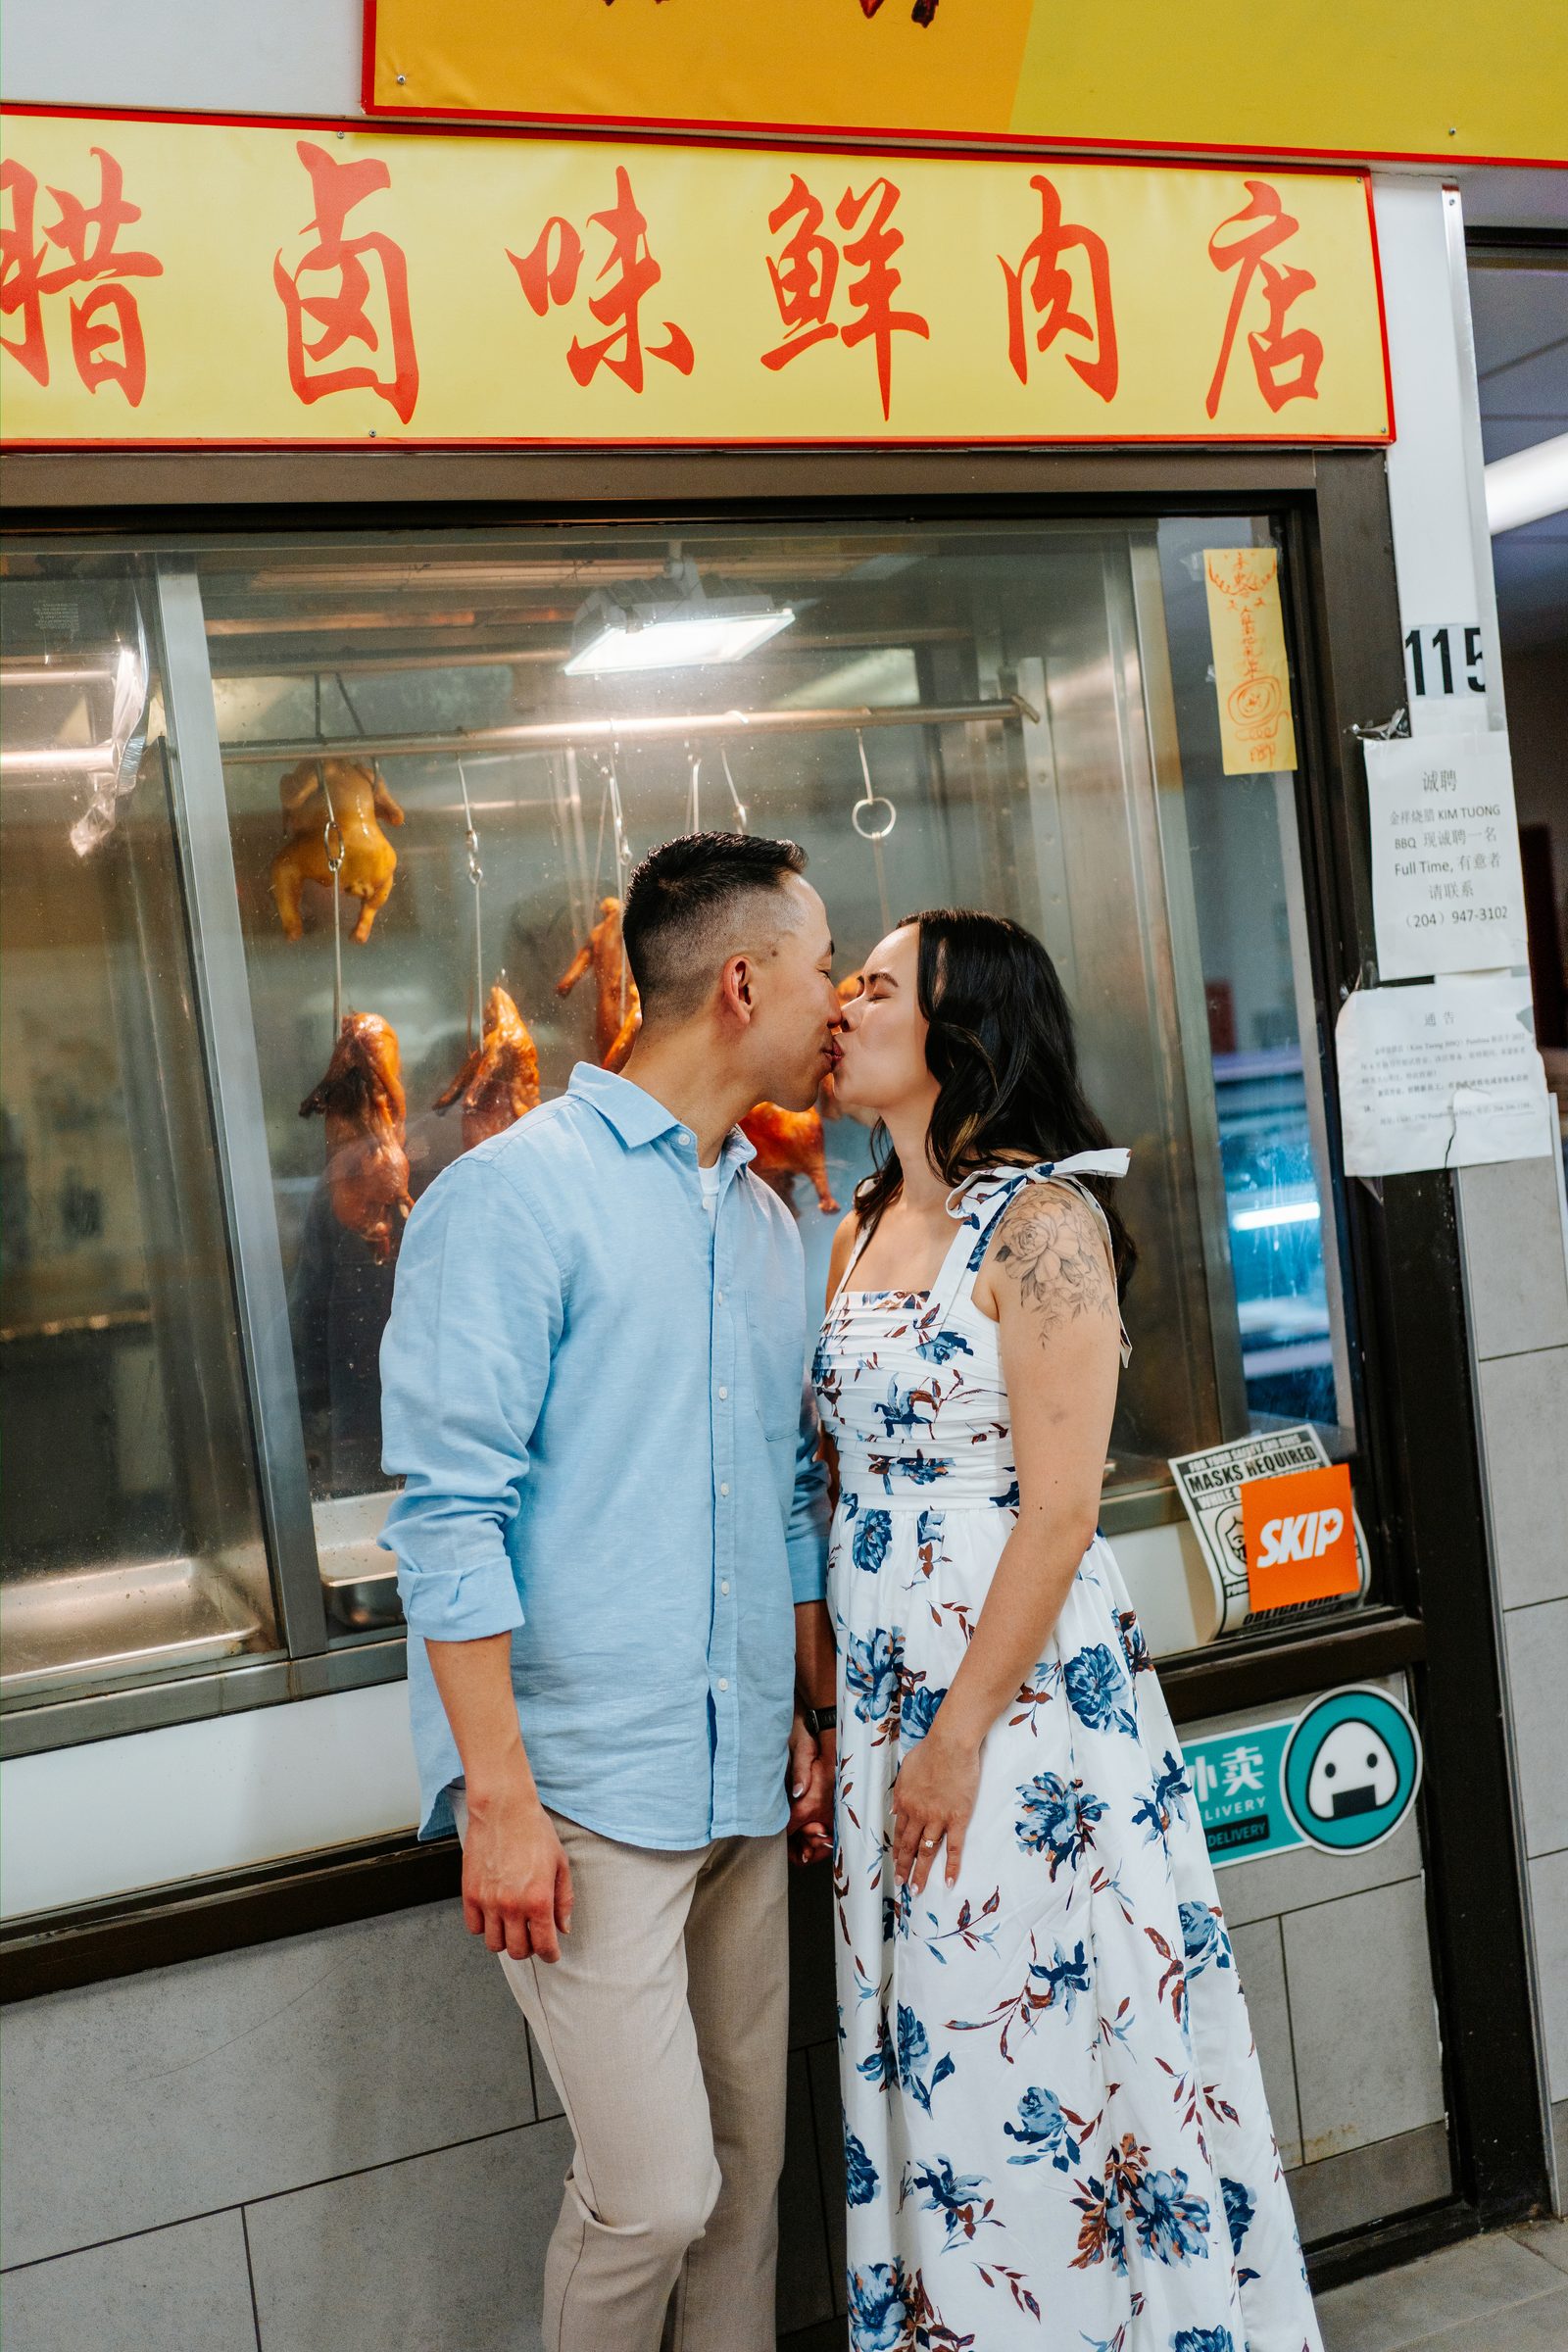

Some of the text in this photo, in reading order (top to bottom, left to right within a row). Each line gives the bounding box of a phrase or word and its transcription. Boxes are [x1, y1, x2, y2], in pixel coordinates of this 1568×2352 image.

[1404, 627, 1486, 696] 115
[1422, 769, 1457, 792] 诚聘
[1438, 808, 1458, 821] KIM
[1460, 805, 1500, 819] TUONG
[1395, 837, 1416, 850] BBQ
[1395, 861, 1416, 876] Full
[1419, 860, 1453, 874] Time,
[1430, 880, 1474, 901] 请联系
[1451, 906, 1507, 924] 947-3102
[1188, 1464, 1244, 1494] MASKS
[1244, 1445, 1317, 1478] REQUIRED
[1256, 1507, 1345, 1568] SKIP
[1207, 1823, 1266, 1847] DELIVERY
